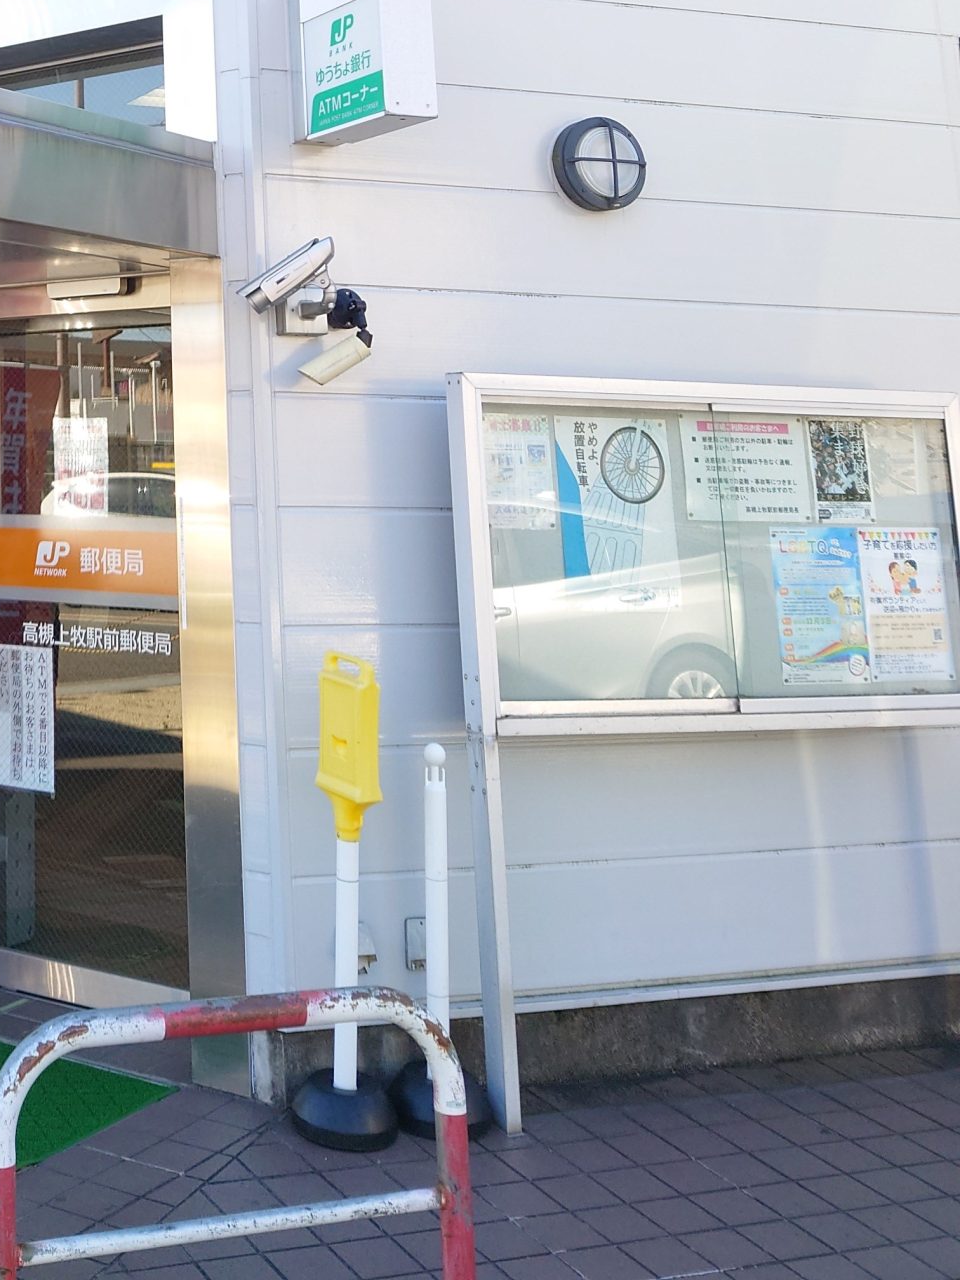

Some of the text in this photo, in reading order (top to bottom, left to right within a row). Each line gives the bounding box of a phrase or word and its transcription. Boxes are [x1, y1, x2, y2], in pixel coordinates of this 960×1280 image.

[329, 42, 353, 57] BANK
[316, 49, 371, 86] ゆうちょ銀行
[318, 84, 378, 117] ATMコーナー
[34, 567, 67, 577] NETWORK
[80, 547, 144, 576] 郵便局
[22, 622, 172, 656] 高槻上牧駅前郵便局
